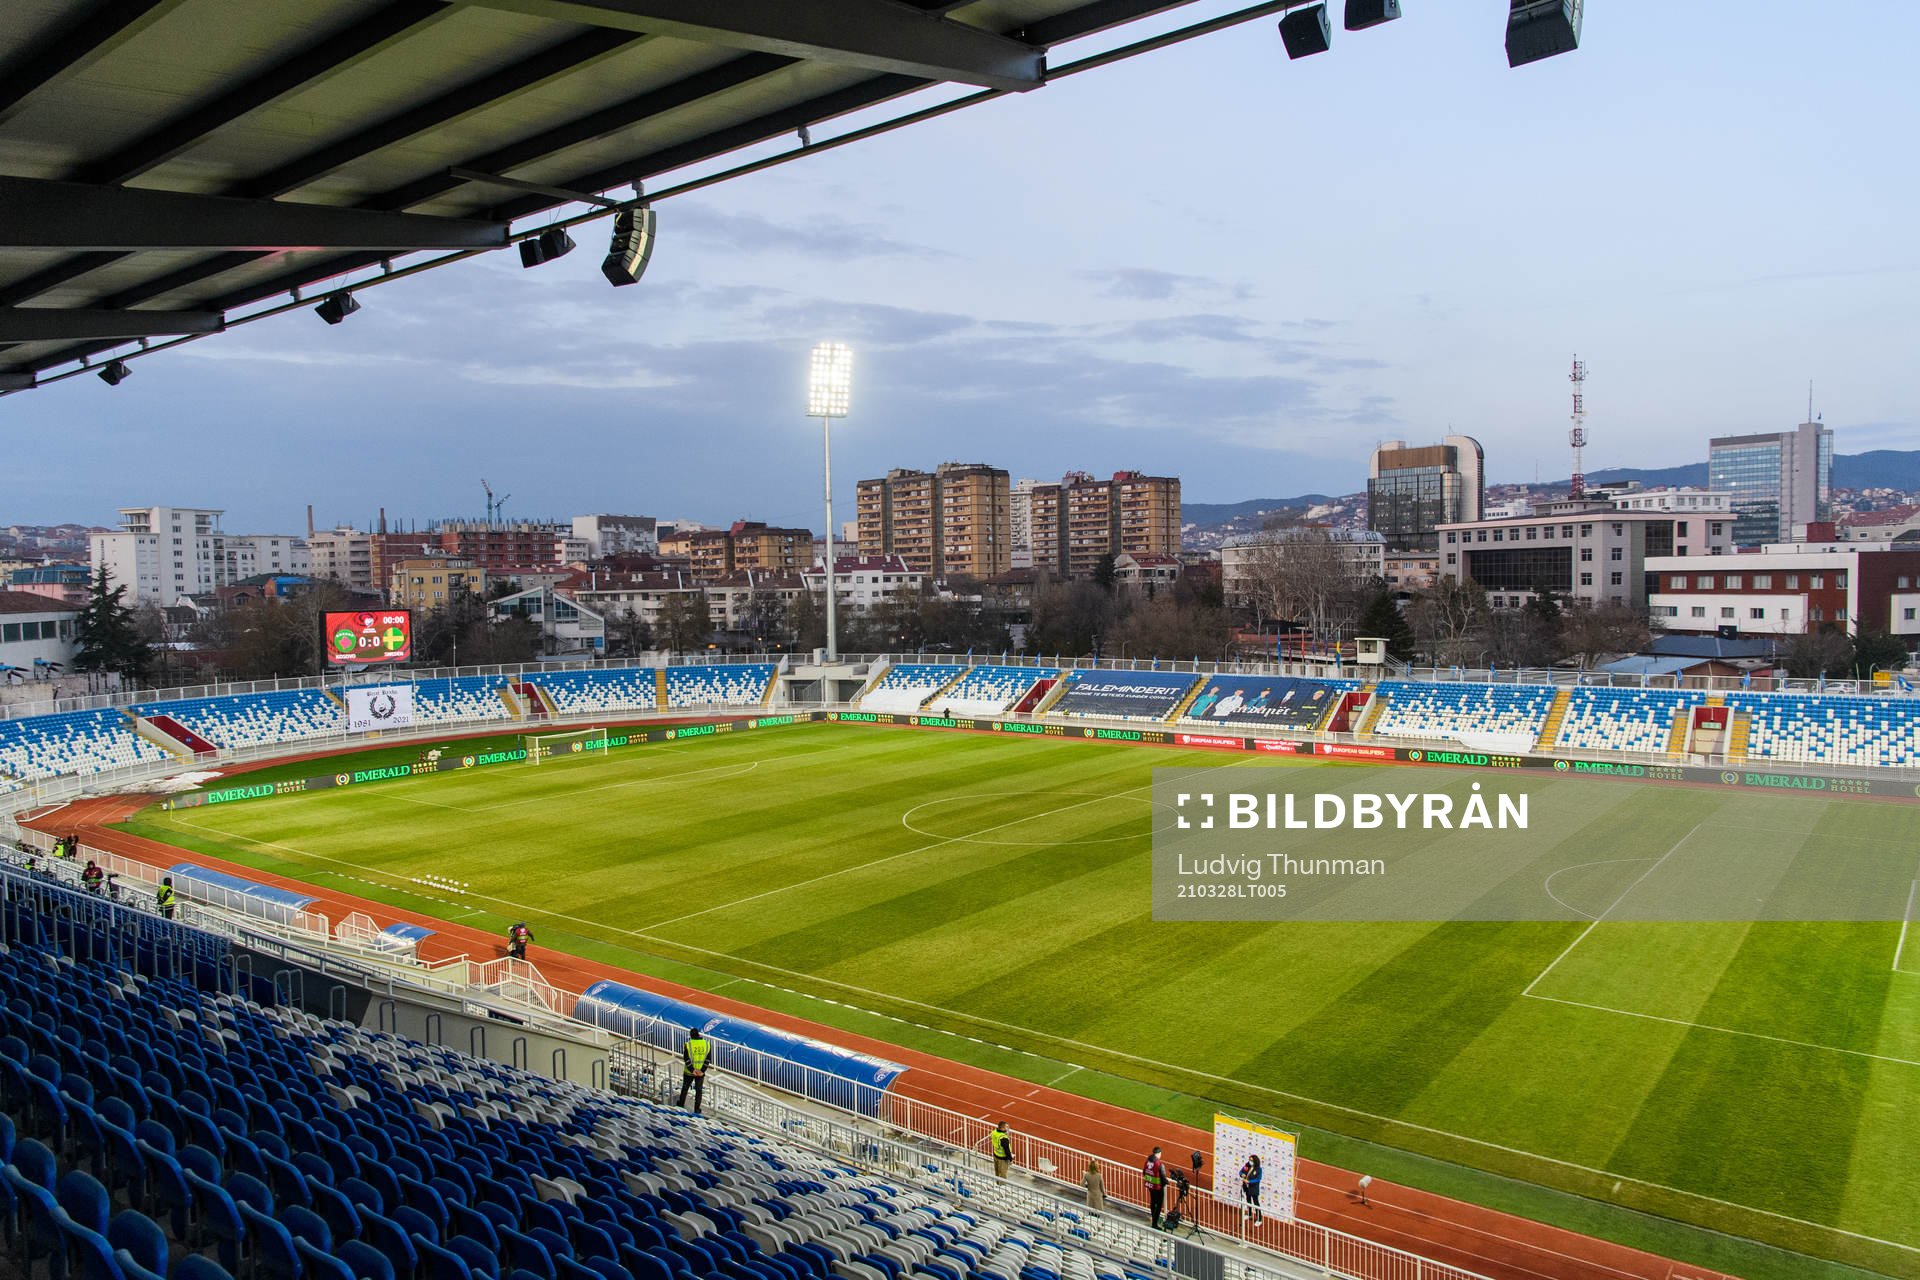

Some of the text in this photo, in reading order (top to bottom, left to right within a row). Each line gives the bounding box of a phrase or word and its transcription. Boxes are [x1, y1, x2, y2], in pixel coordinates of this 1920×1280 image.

[383, 616, 404, 624] 00:00
[1075, 684, 1180, 694] FALEMINDERIT
[759, 716, 792, 726] EMERALD
[840, 713, 876, 722] EMERALD
[920, 718, 956, 727] EMERALD
[678, 726, 714, 737] EMERALD
[1004, 722, 1043, 734] EMERALD
[1098, 730, 1140, 740] EMERALD
[586, 736, 627, 750] EMERALD
[479, 750, 526, 764] EMERALD
[1427, 752, 1488, 766] EMERALD
[355, 766, 438, 782] EMERALD HOTEL
[1575, 762, 1684, 780] EMERALD HOTEL
[1745, 773, 1871, 794] EMERALD HOTEL
[208, 784, 306, 804] EMERALD HOTEL
